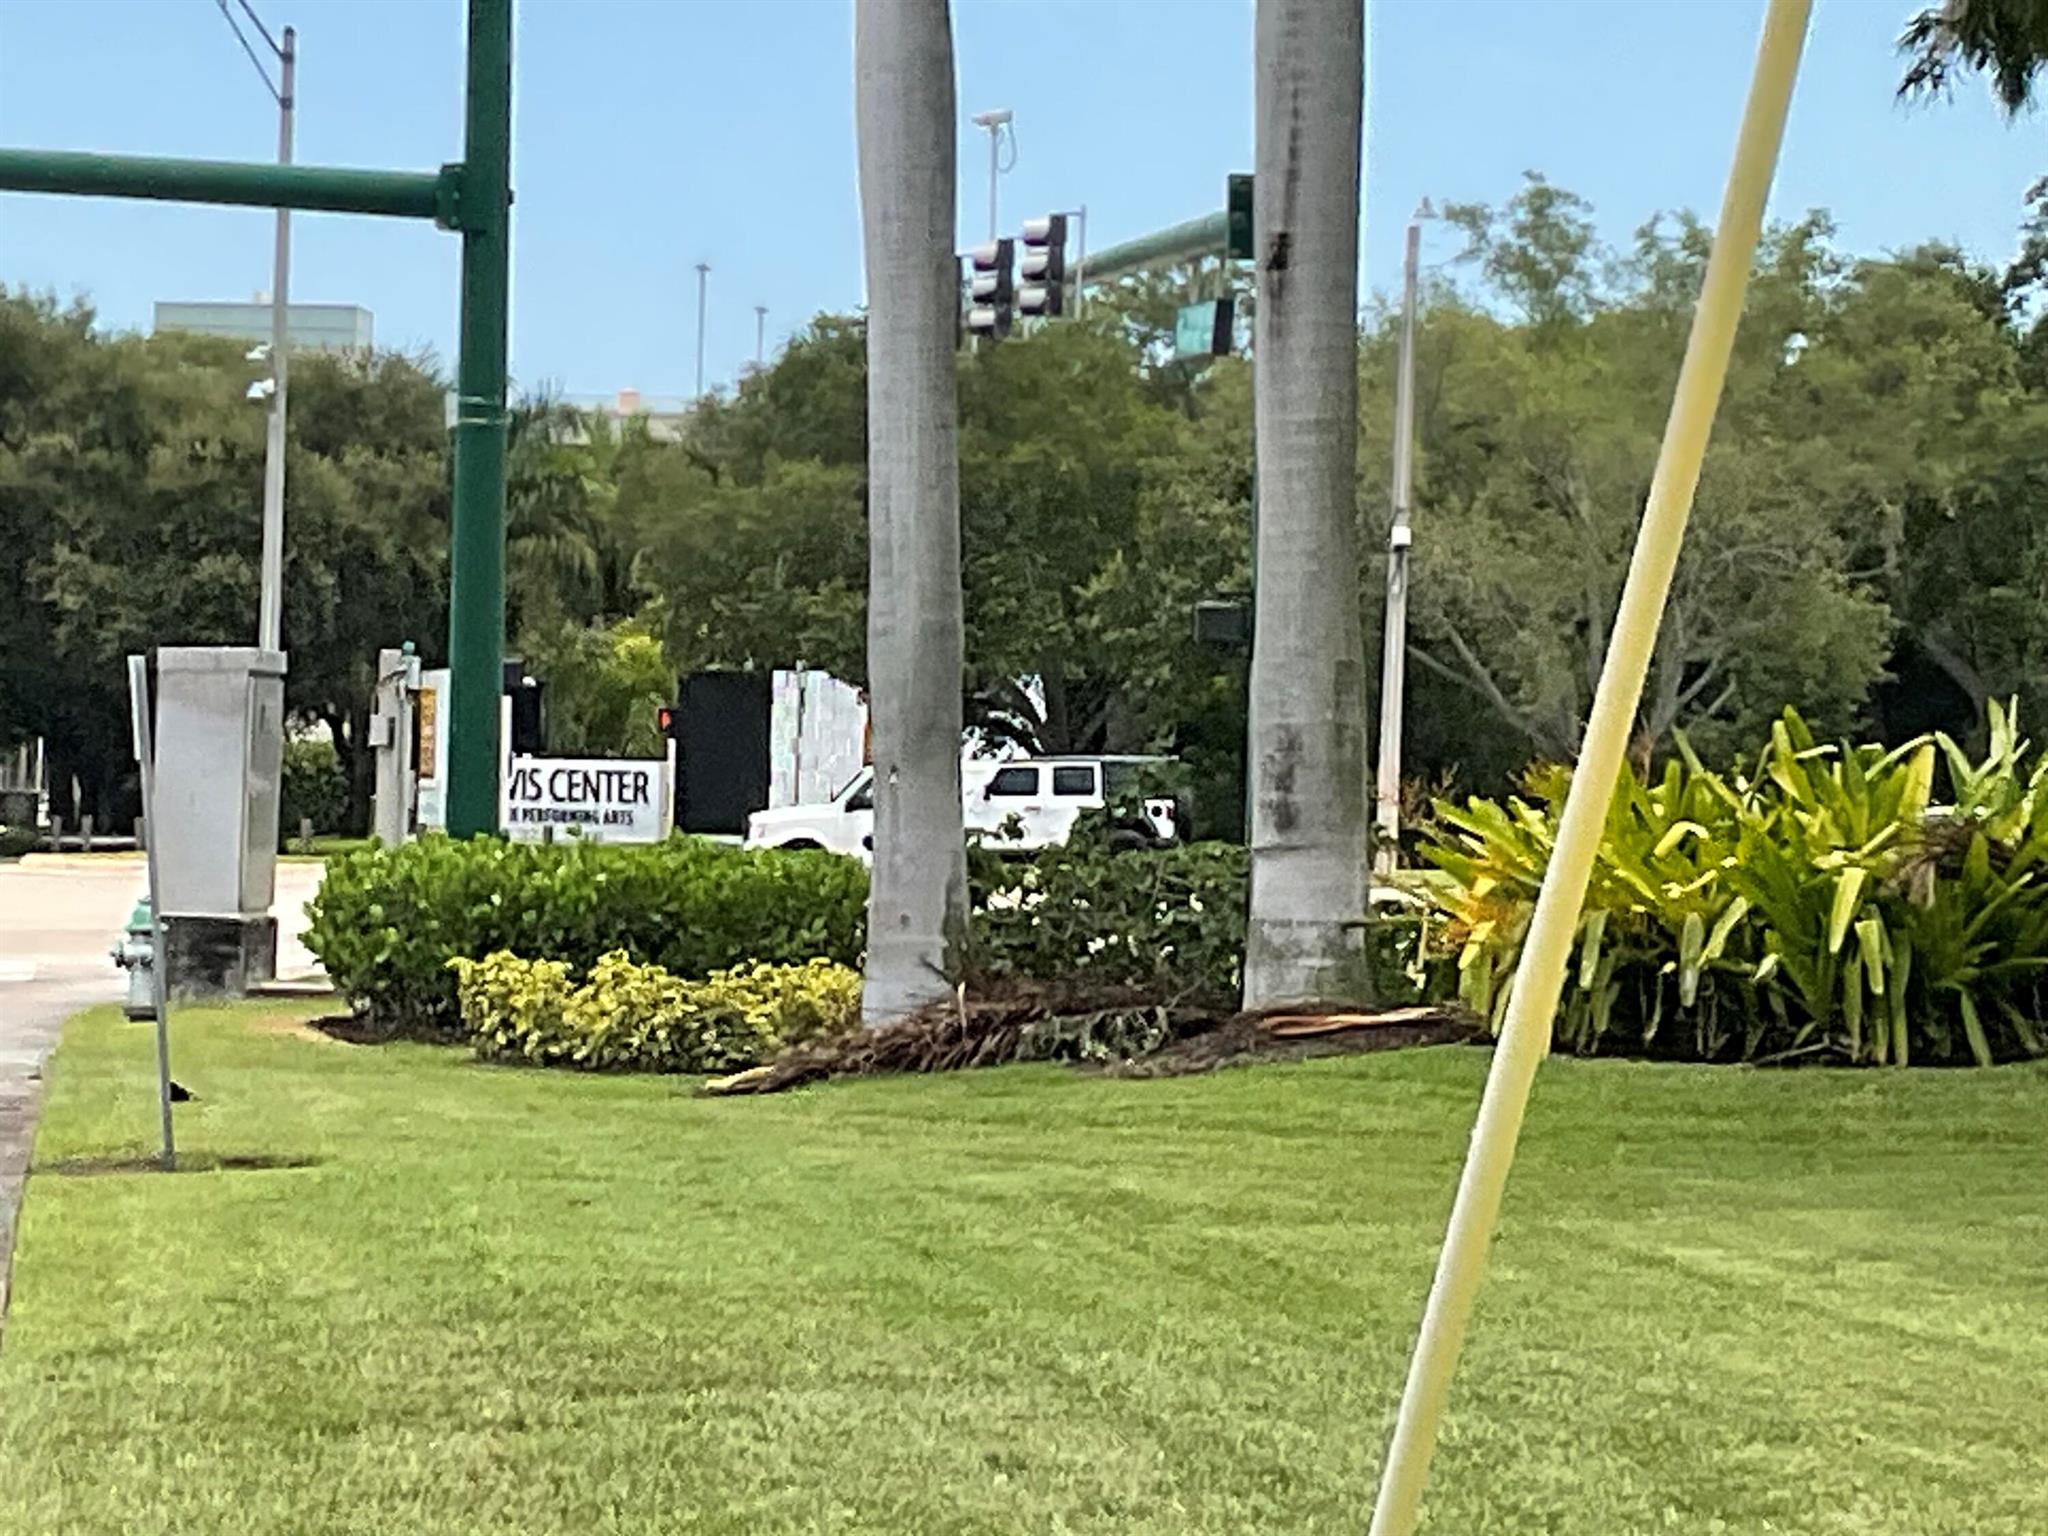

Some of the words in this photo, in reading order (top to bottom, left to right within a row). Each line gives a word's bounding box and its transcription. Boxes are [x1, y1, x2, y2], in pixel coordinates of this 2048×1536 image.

[549, 769, 649, 803] CENTER
[522, 807, 600, 824] PERFORMING
[603, 809, 634, 826] ARTS
